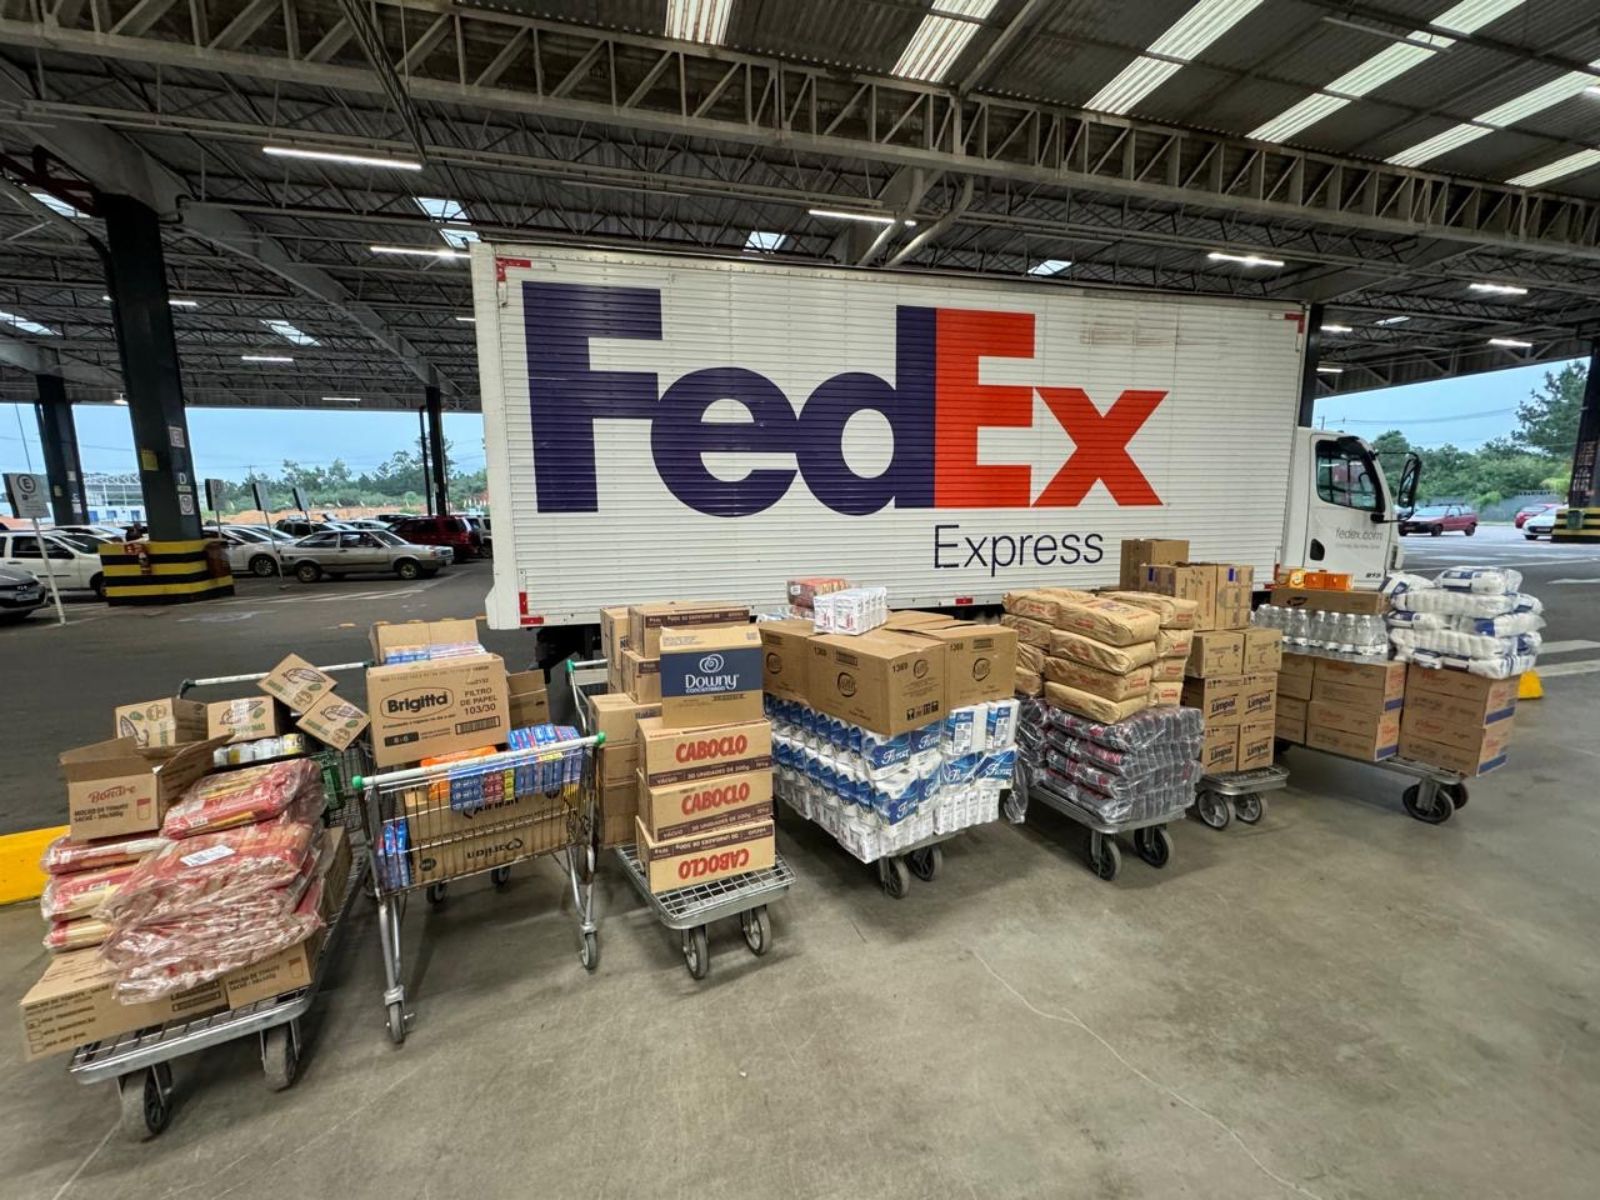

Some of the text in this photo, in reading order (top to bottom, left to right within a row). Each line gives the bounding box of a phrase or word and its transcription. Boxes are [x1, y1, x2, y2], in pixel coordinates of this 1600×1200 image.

[522, 280, 1169, 517] FedEx
[934, 524, 1103, 577] Express
[464, 687, 492, 697] FILTRO
[685, 674, 737, 690] Downy
[387, 692, 448, 713] Brigitta
[464, 703, 496, 716] 103/30
[473, 695, 498, 705] PAPEL
[675, 734, 748, 763] CABOCLO
[681, 782, 750, 815] CABOCLO
[678, 848, 749, 880] CABOCLO
